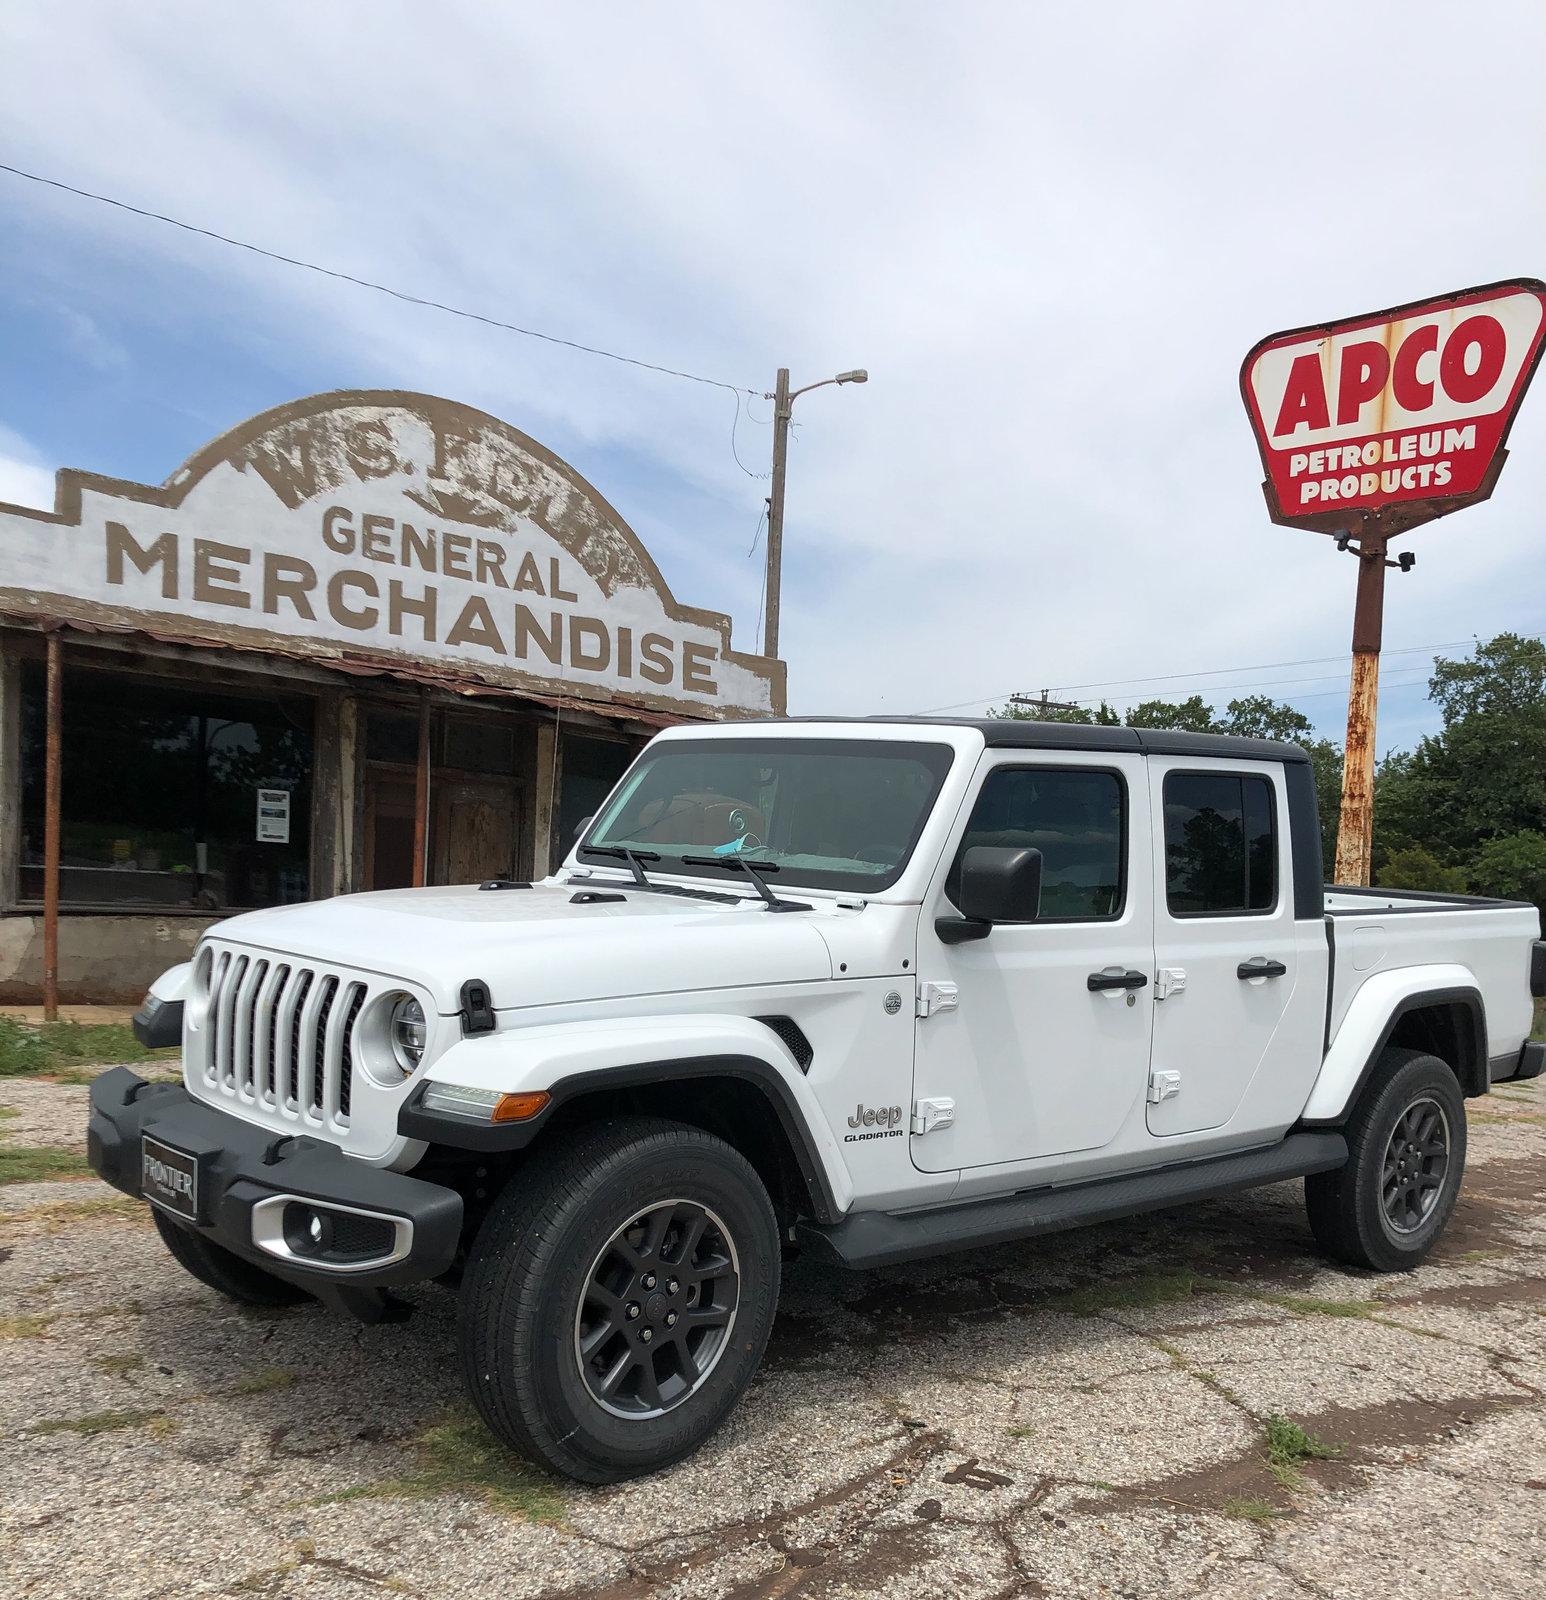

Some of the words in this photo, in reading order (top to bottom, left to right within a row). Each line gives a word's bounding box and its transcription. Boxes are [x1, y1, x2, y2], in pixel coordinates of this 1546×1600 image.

[1273, 315, 1507, 438] APCO
[1289, 424, 1477, 478] PETROLEUM
[1300, 460, 1453, 505] PRODUCTS
[322, 504, 579, 604] GENERAL
[104, 520, 719, 696] MERCHANDISE
[844, 1129, 904, 1143] GLADIATOR
[847, 1103, 902, 1129] Jeep
[144, 1153, 194, 1201] FRONTIER
